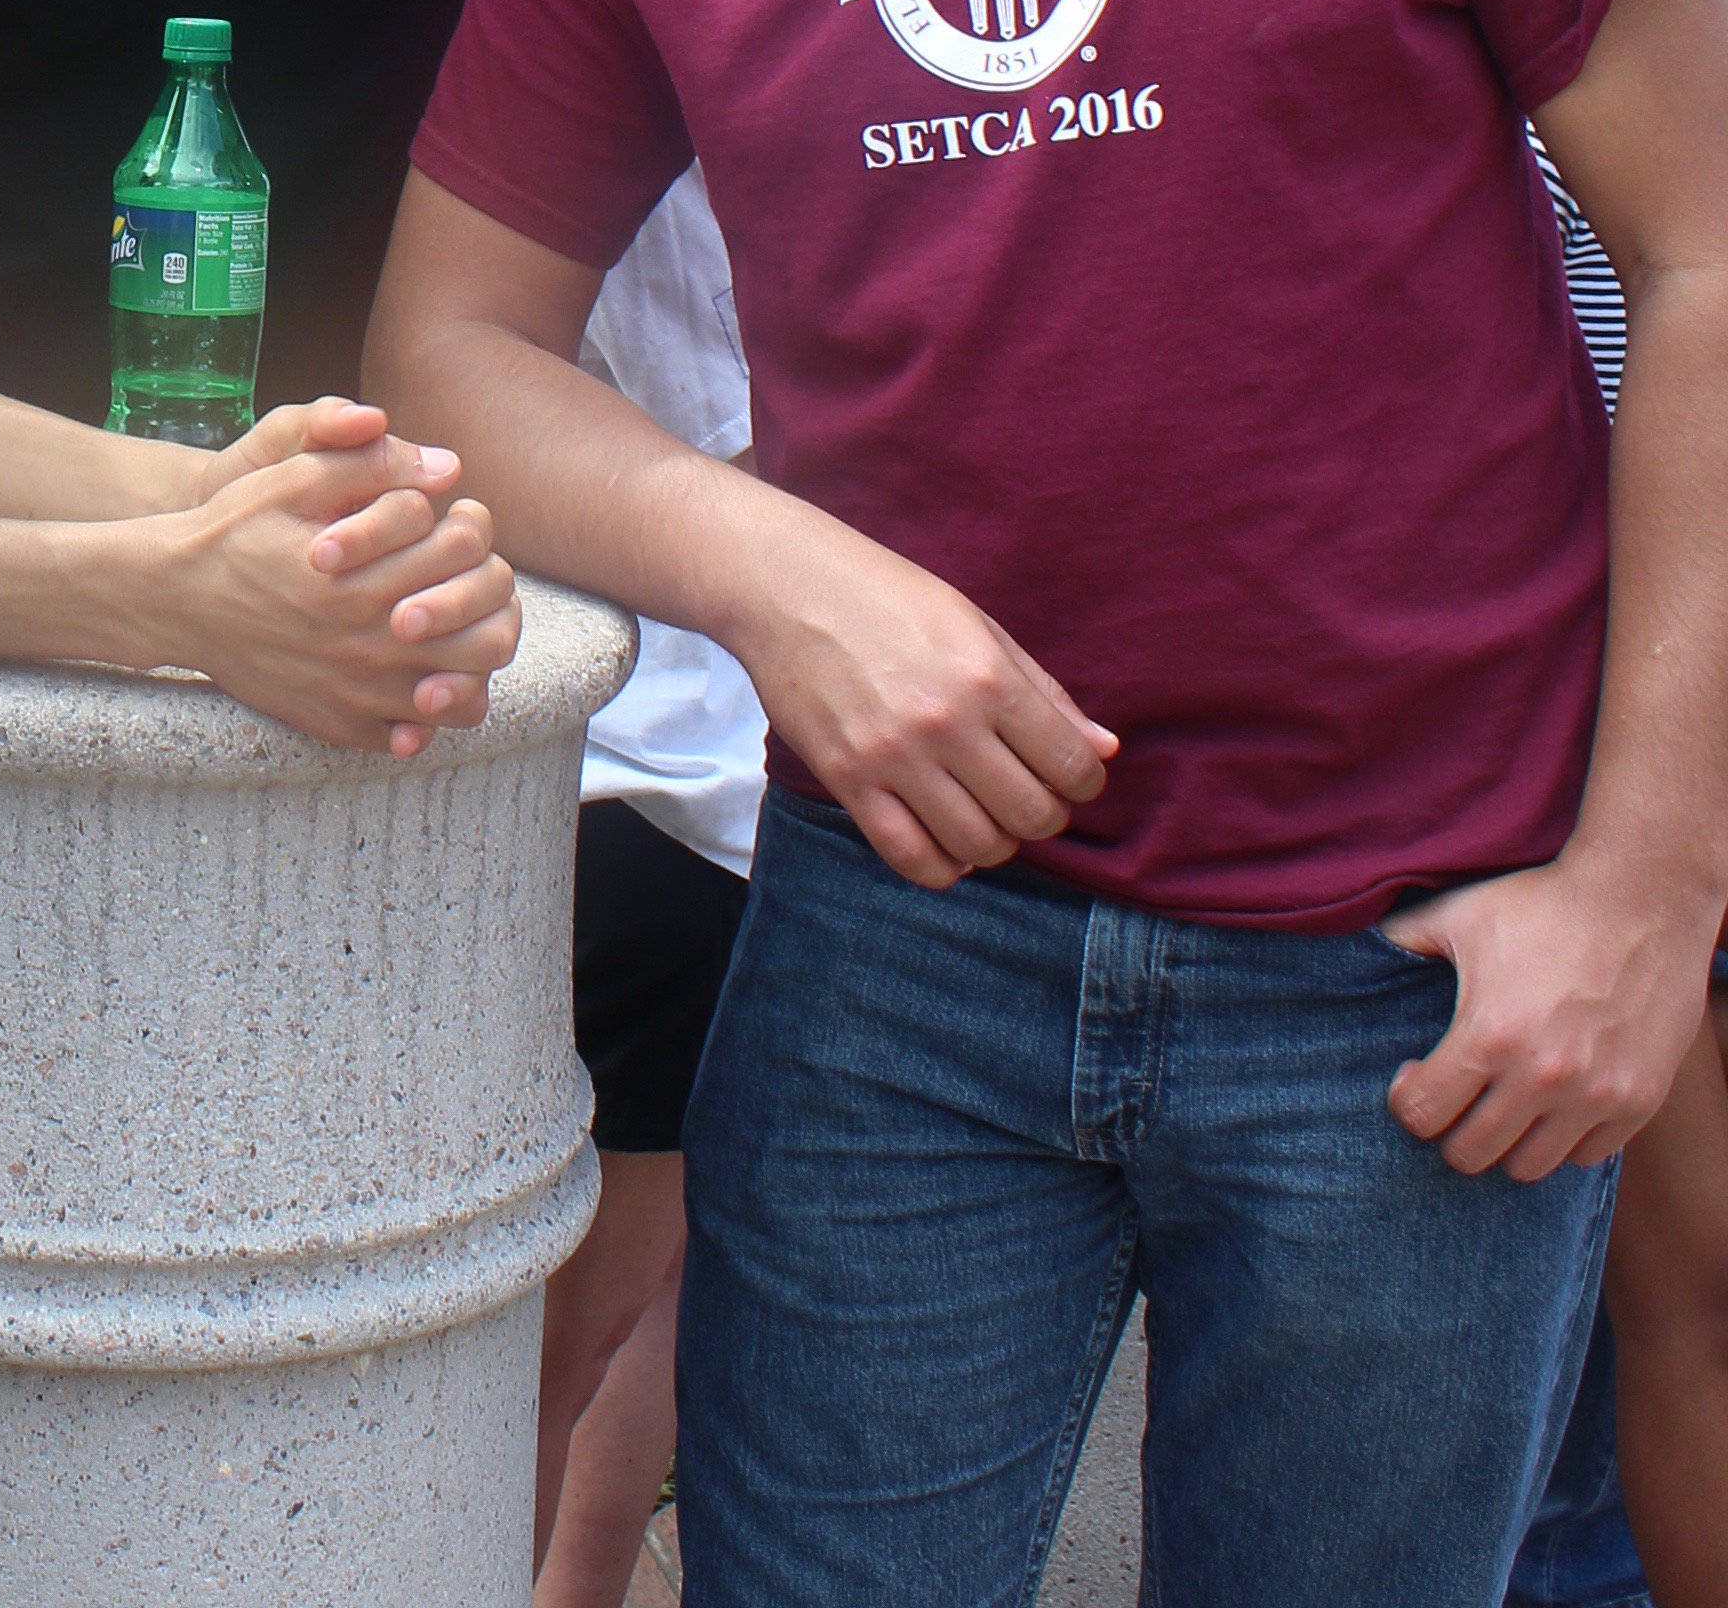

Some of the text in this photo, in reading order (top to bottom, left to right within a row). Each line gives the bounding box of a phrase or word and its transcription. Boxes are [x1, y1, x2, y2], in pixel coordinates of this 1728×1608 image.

[982, 47, 1040, 75] 1851
[862, 84, 1164, 170] SETCA 2016
[165, 256, 185, 269] 240
